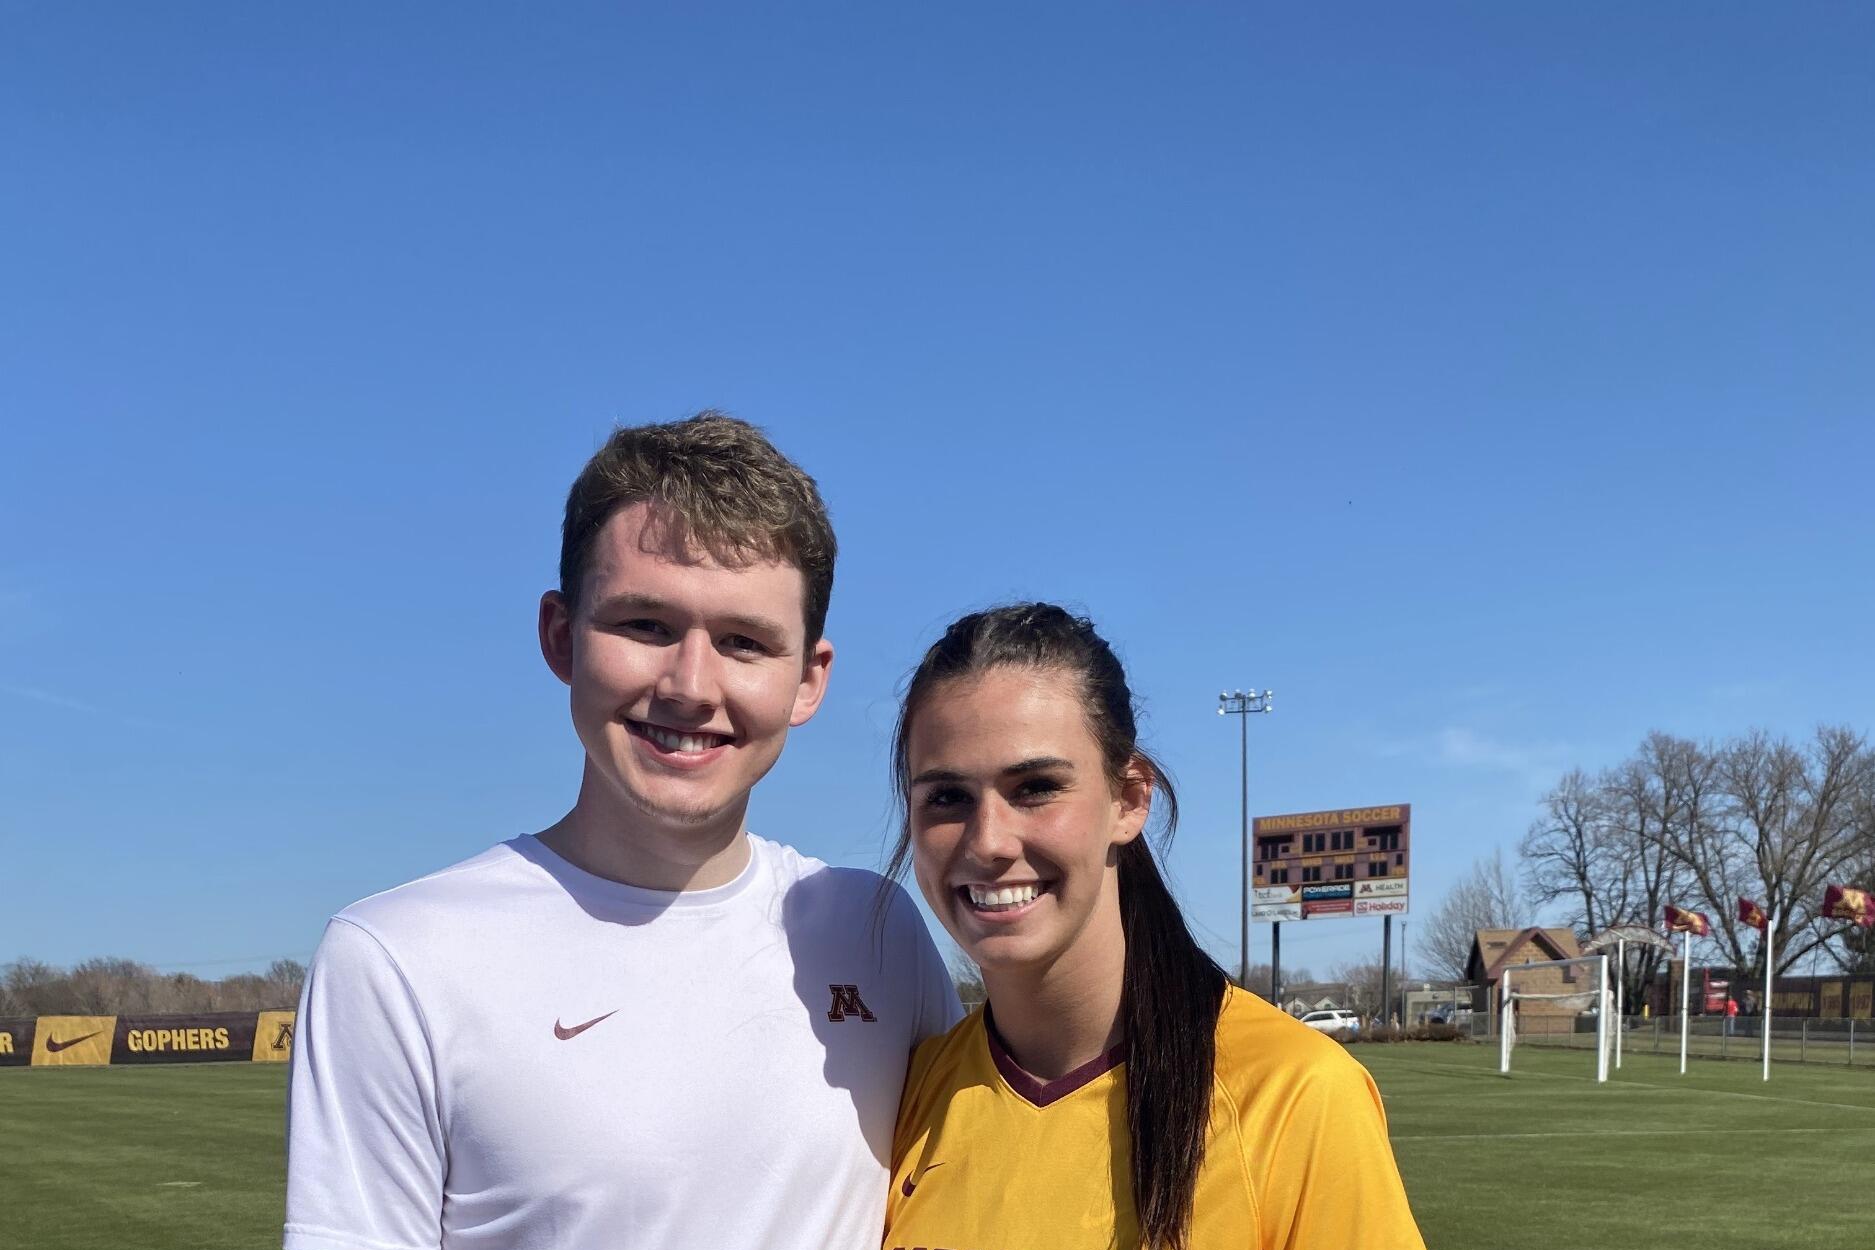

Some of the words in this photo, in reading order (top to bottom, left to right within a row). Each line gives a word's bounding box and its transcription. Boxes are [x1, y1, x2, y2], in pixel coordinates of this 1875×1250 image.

[1260, 814, 1339, 830] MINNESOTA
[1343, 807, 1400, 822] SOCCER
[1369, 902, 1405, 912] Holiday
[128, 1028, 230, 1052] GOPHERS
